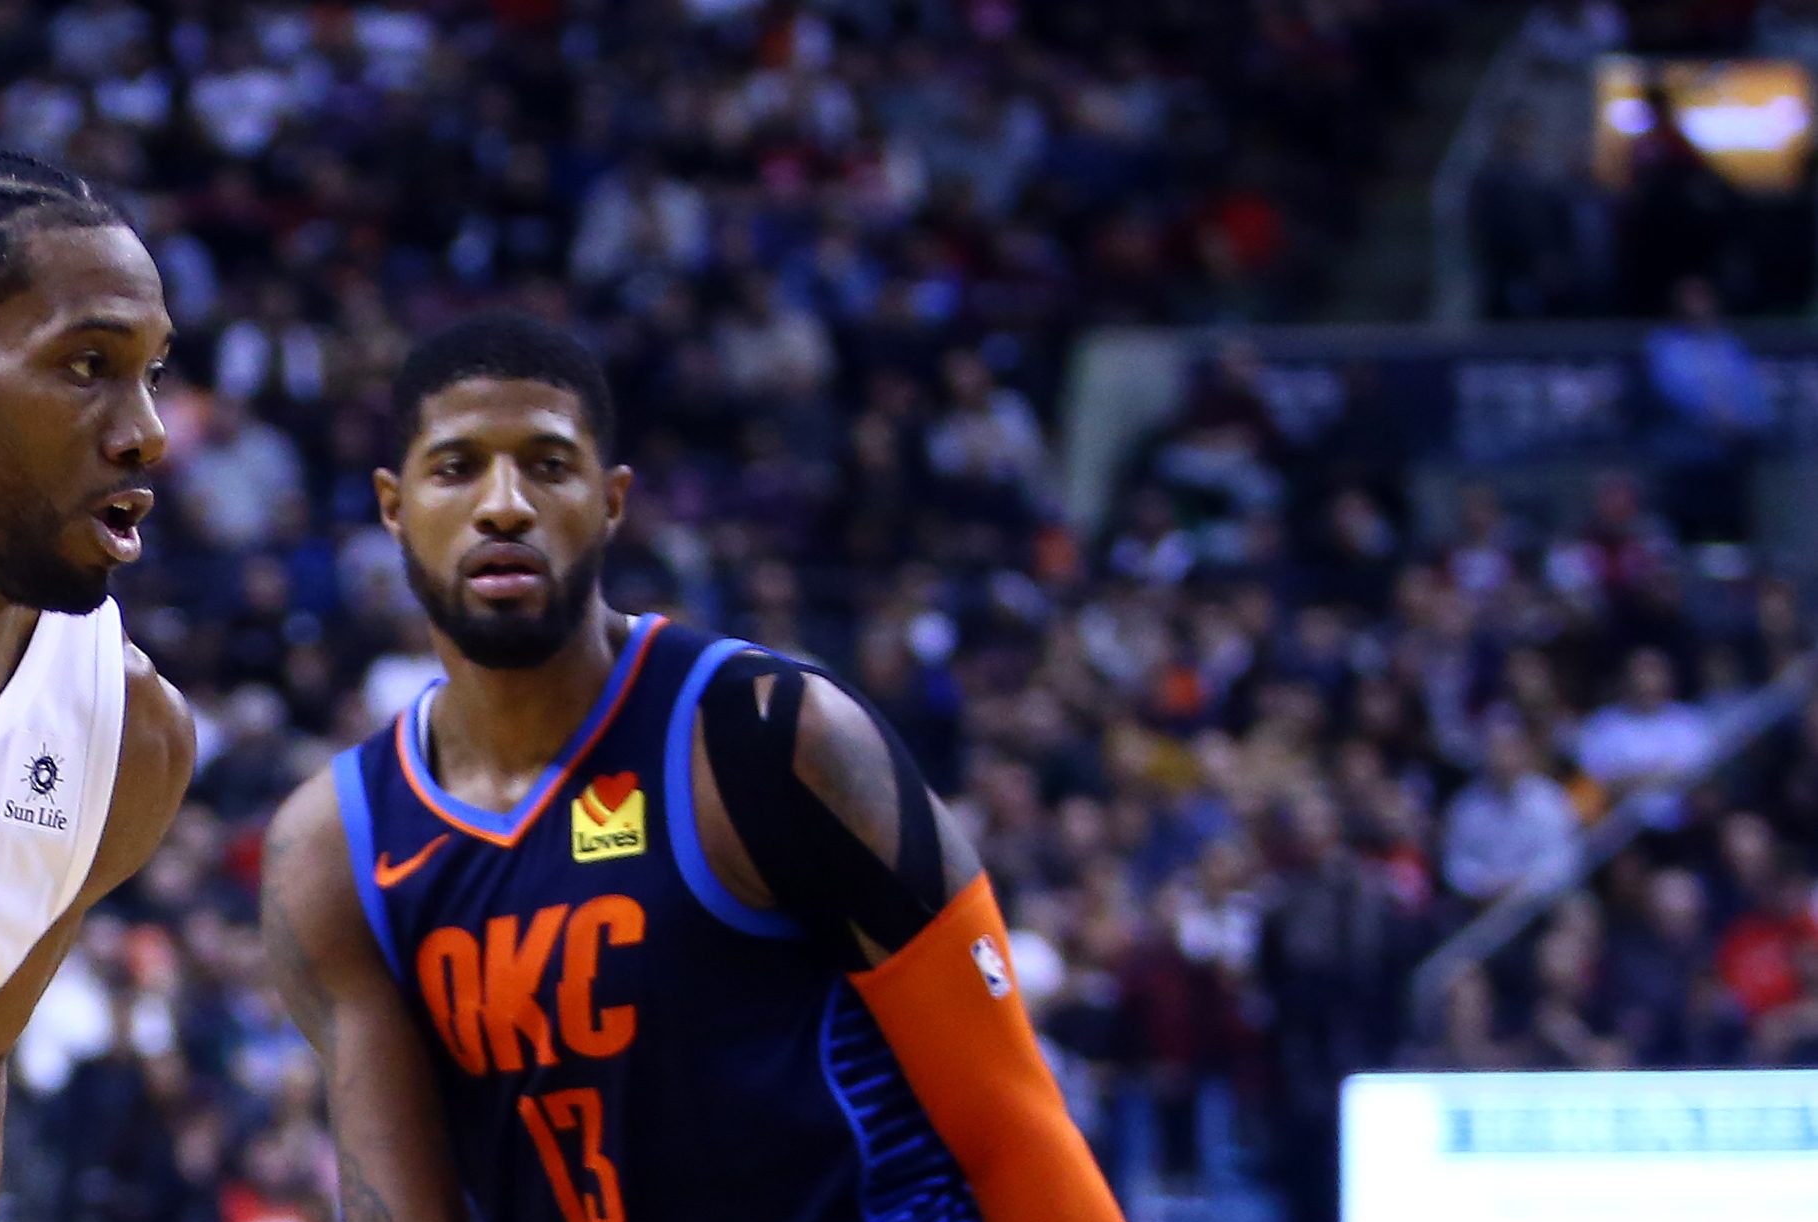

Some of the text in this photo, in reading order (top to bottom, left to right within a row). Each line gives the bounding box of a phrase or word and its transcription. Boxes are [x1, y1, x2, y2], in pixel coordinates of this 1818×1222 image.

[3, 799, 67, 830] Sun Life
[416, 894, 645, 1076] OKC
